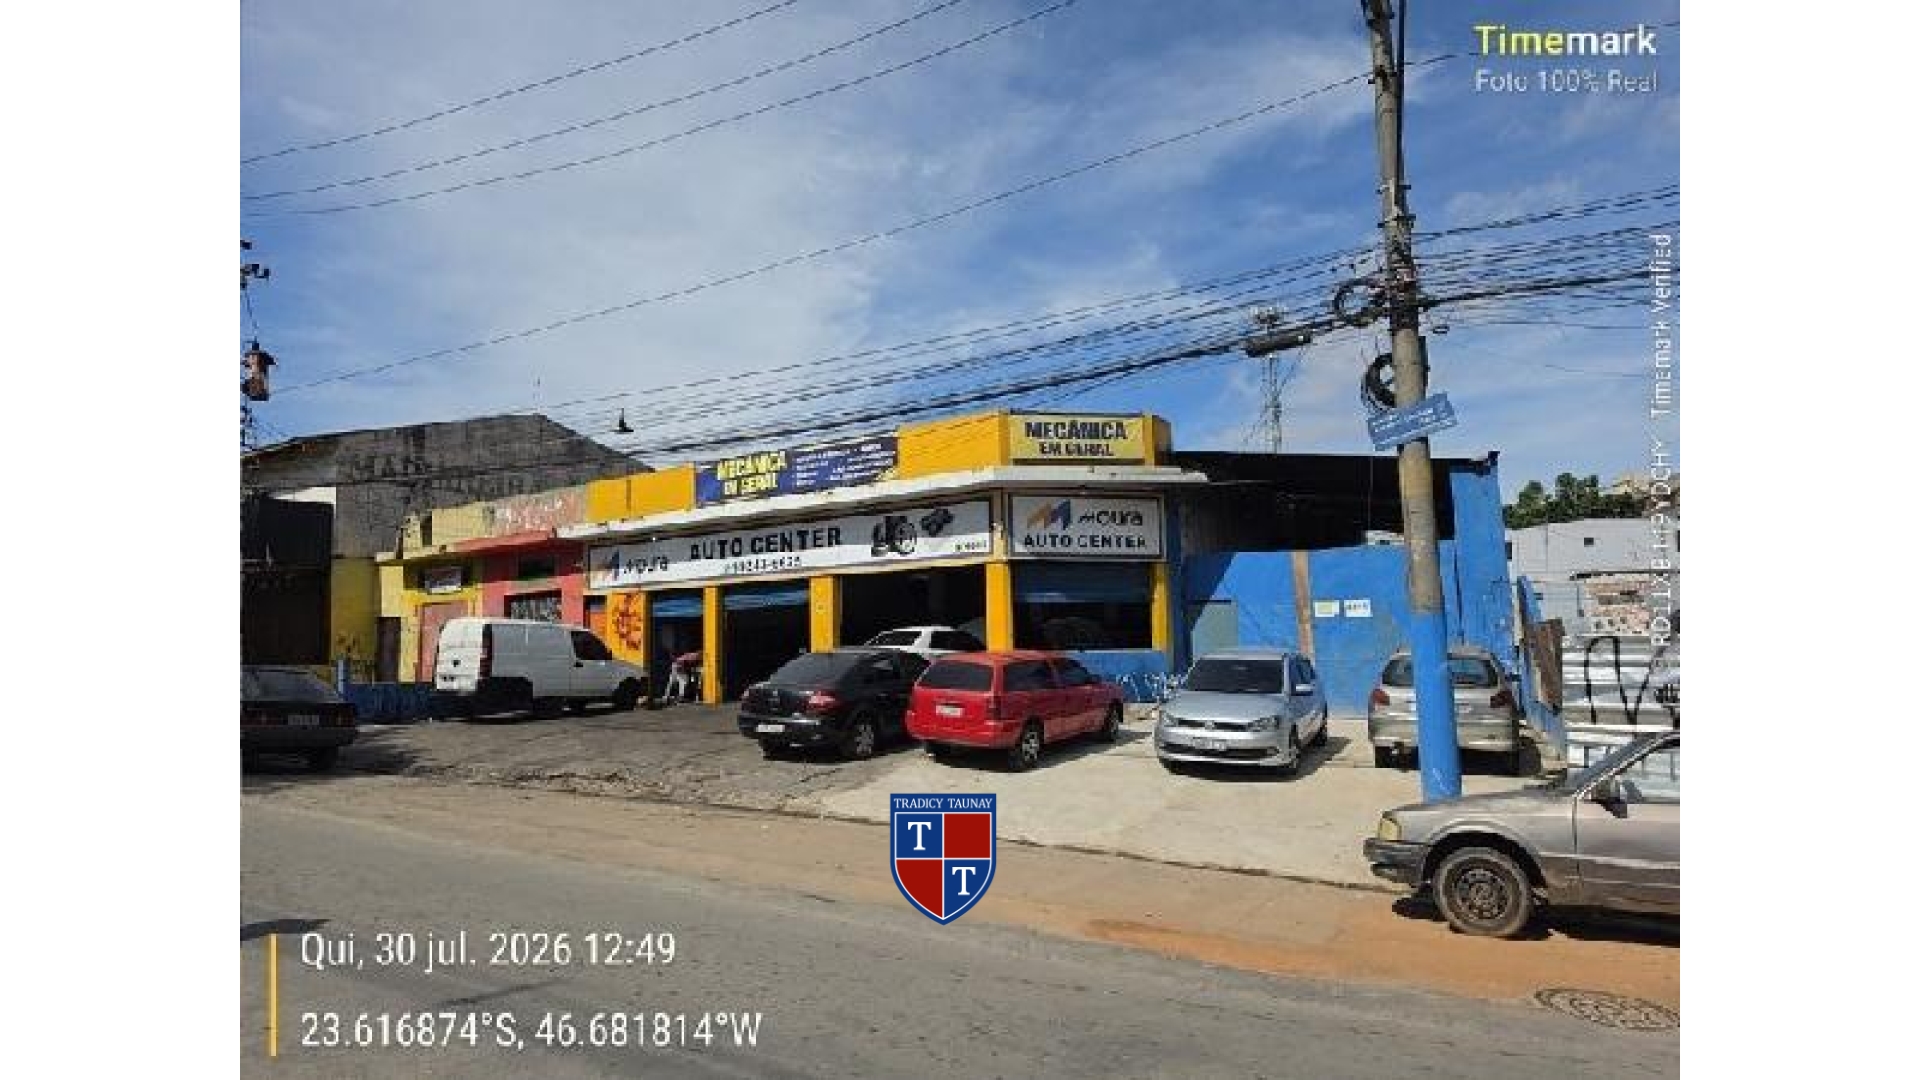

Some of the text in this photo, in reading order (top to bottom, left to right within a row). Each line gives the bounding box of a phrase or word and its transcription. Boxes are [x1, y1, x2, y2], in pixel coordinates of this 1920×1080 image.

[1024, 420, 1128, 439] MECÂNICA
[1039, 441, 1115, 456] EM GERAL
[690, 527, 842, 560] AUTO CENTER
[1024, 534, 1147, 549] AUTO CENTER
